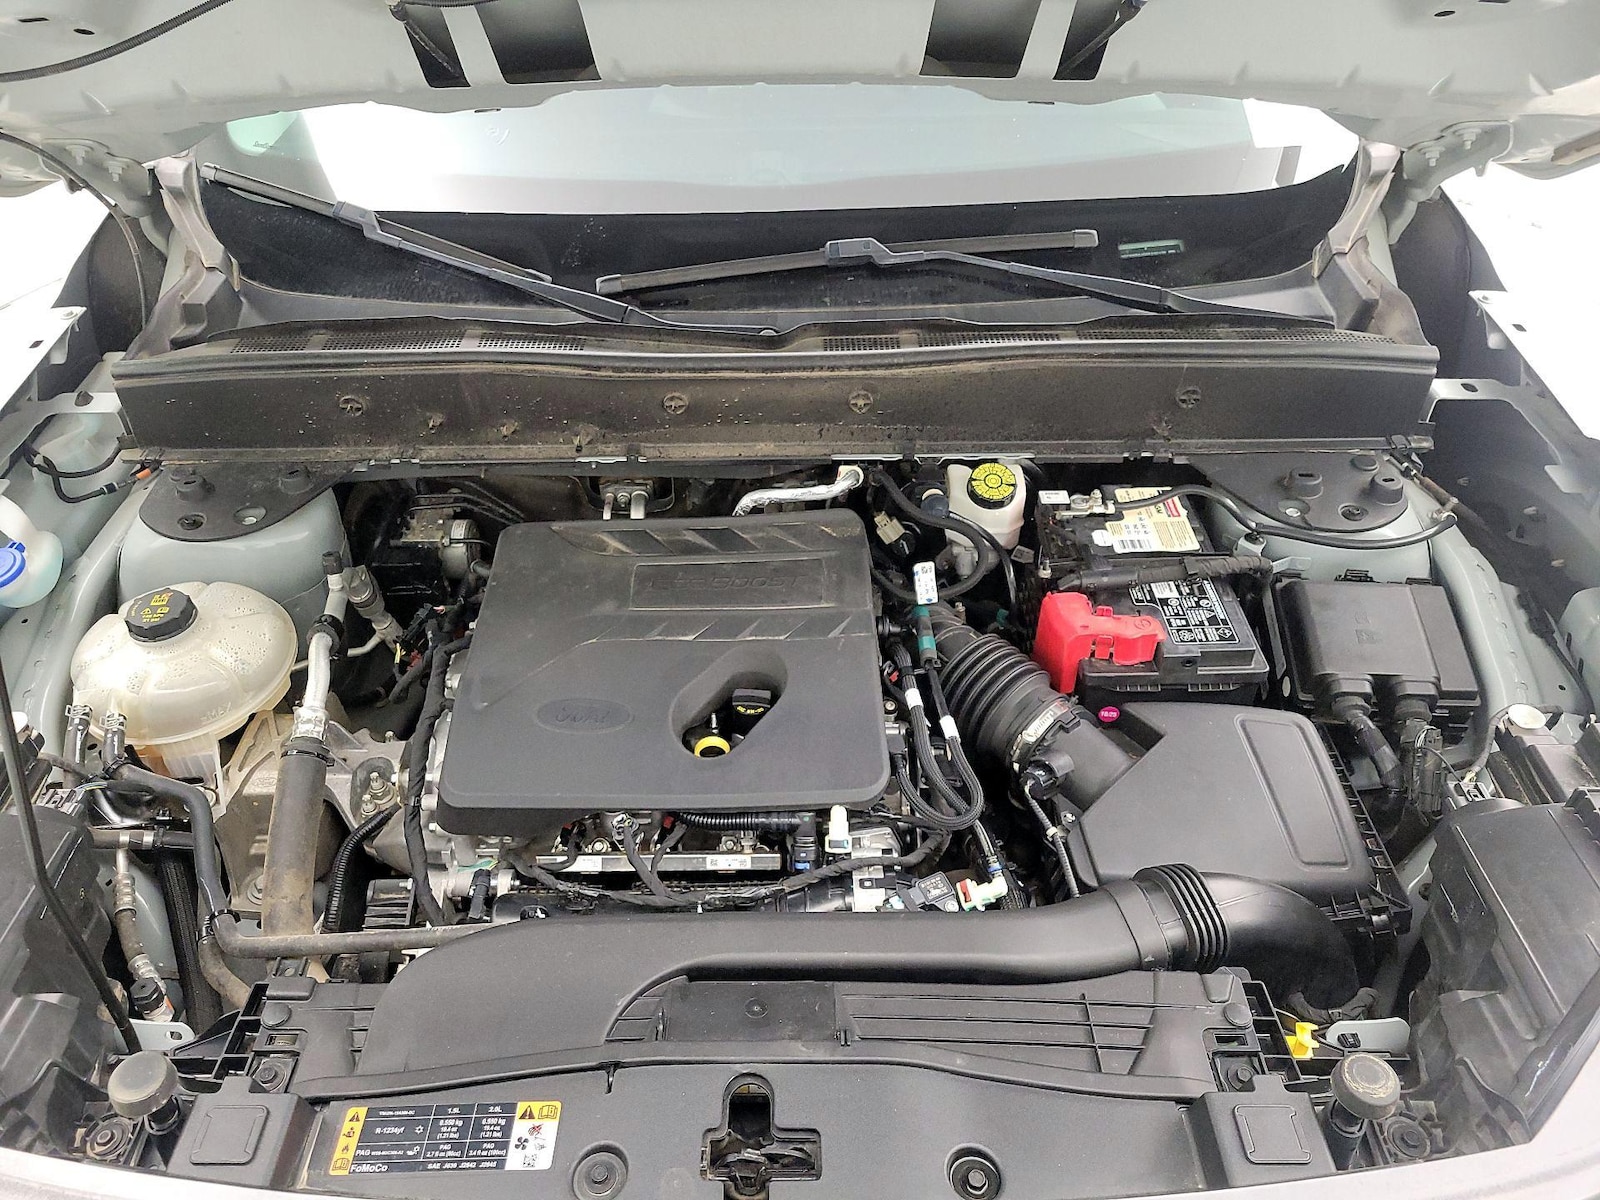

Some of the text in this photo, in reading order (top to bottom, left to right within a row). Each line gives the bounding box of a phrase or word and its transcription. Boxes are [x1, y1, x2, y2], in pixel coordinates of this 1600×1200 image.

[488, 1105, 502, 1113] 2.0L
[456, 1118, 464, 1127] kg
[498, 1117, 507, 1126] kg
[374, 1126, 406, 1135] R-1234yf
[350, 1163, 389, 1173] FoMoCo
